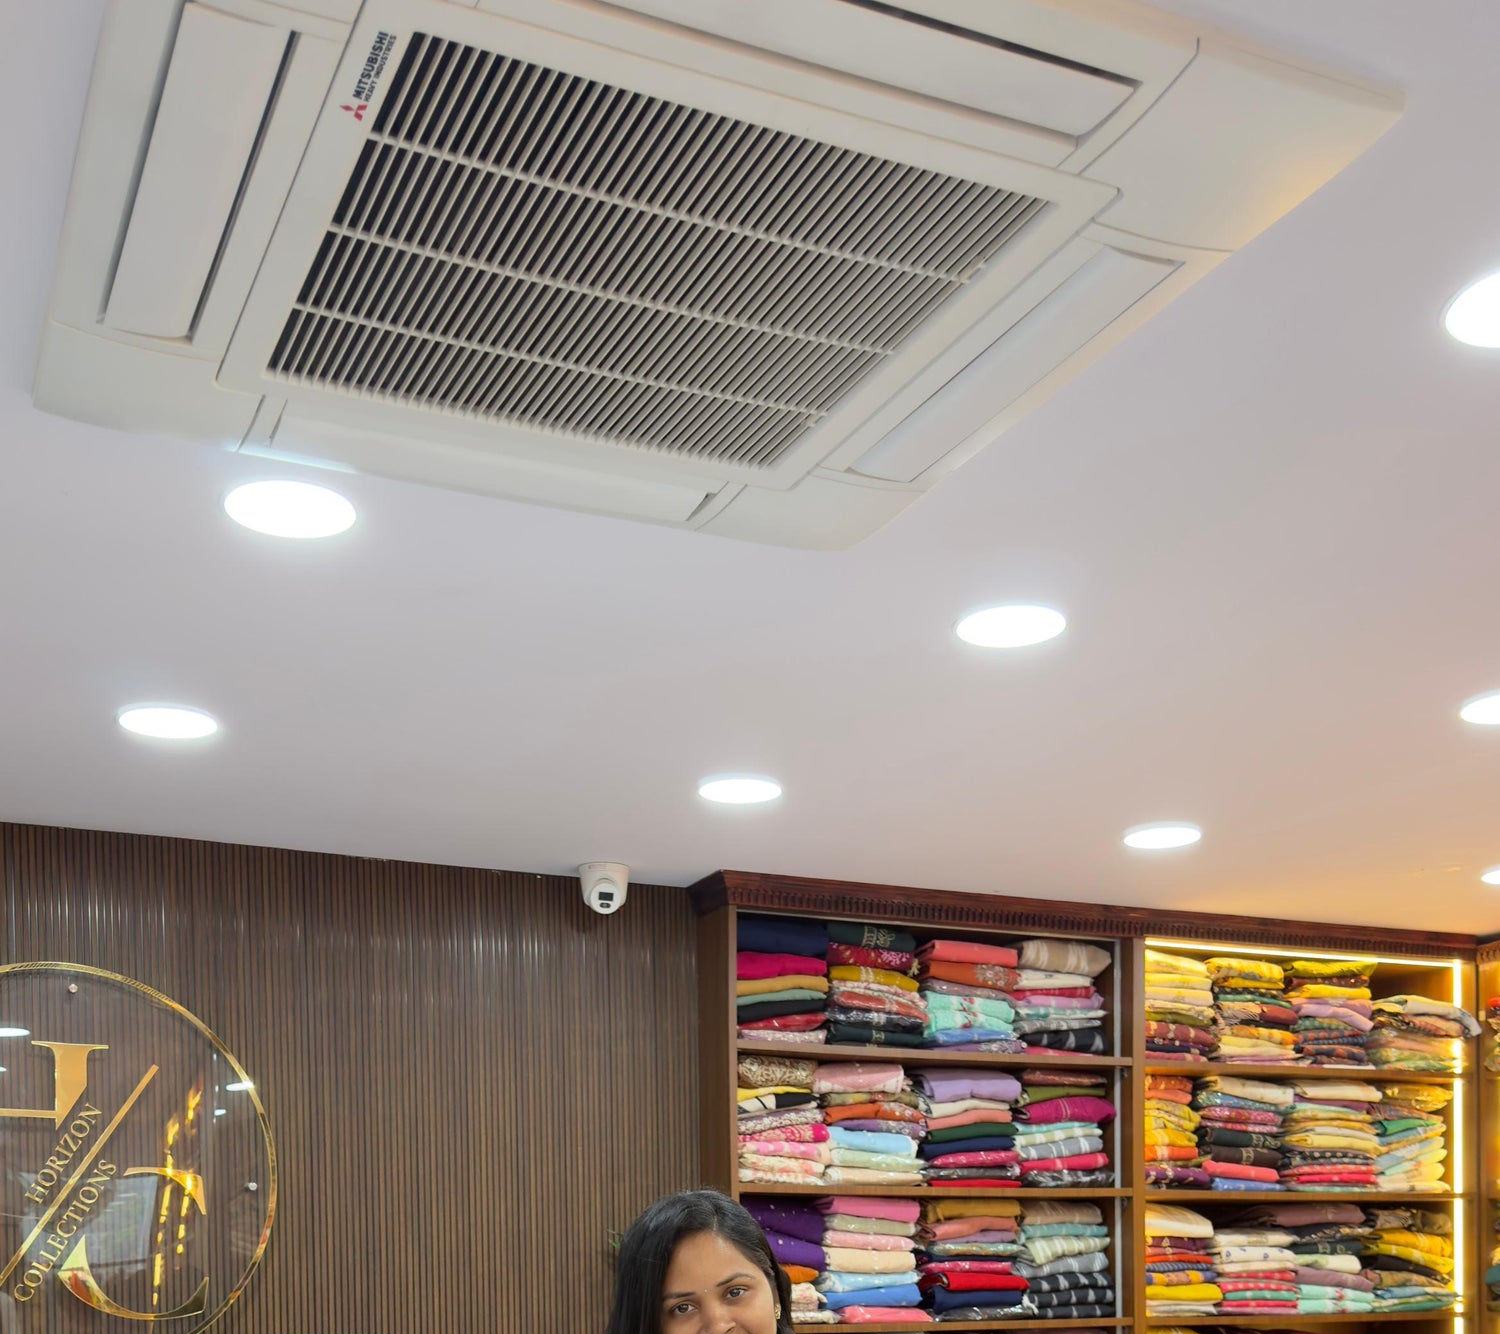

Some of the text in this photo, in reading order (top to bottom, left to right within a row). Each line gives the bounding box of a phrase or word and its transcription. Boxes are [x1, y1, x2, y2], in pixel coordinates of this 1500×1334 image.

[352, 31, 389, 101] MITSUBISHI
[363, 35, 397, 103] HEAVY INDUSTRIES
[24, 1102, 102, 1204] HORIZON
[14, 1159, 117, 1302] COLLECTIONS
